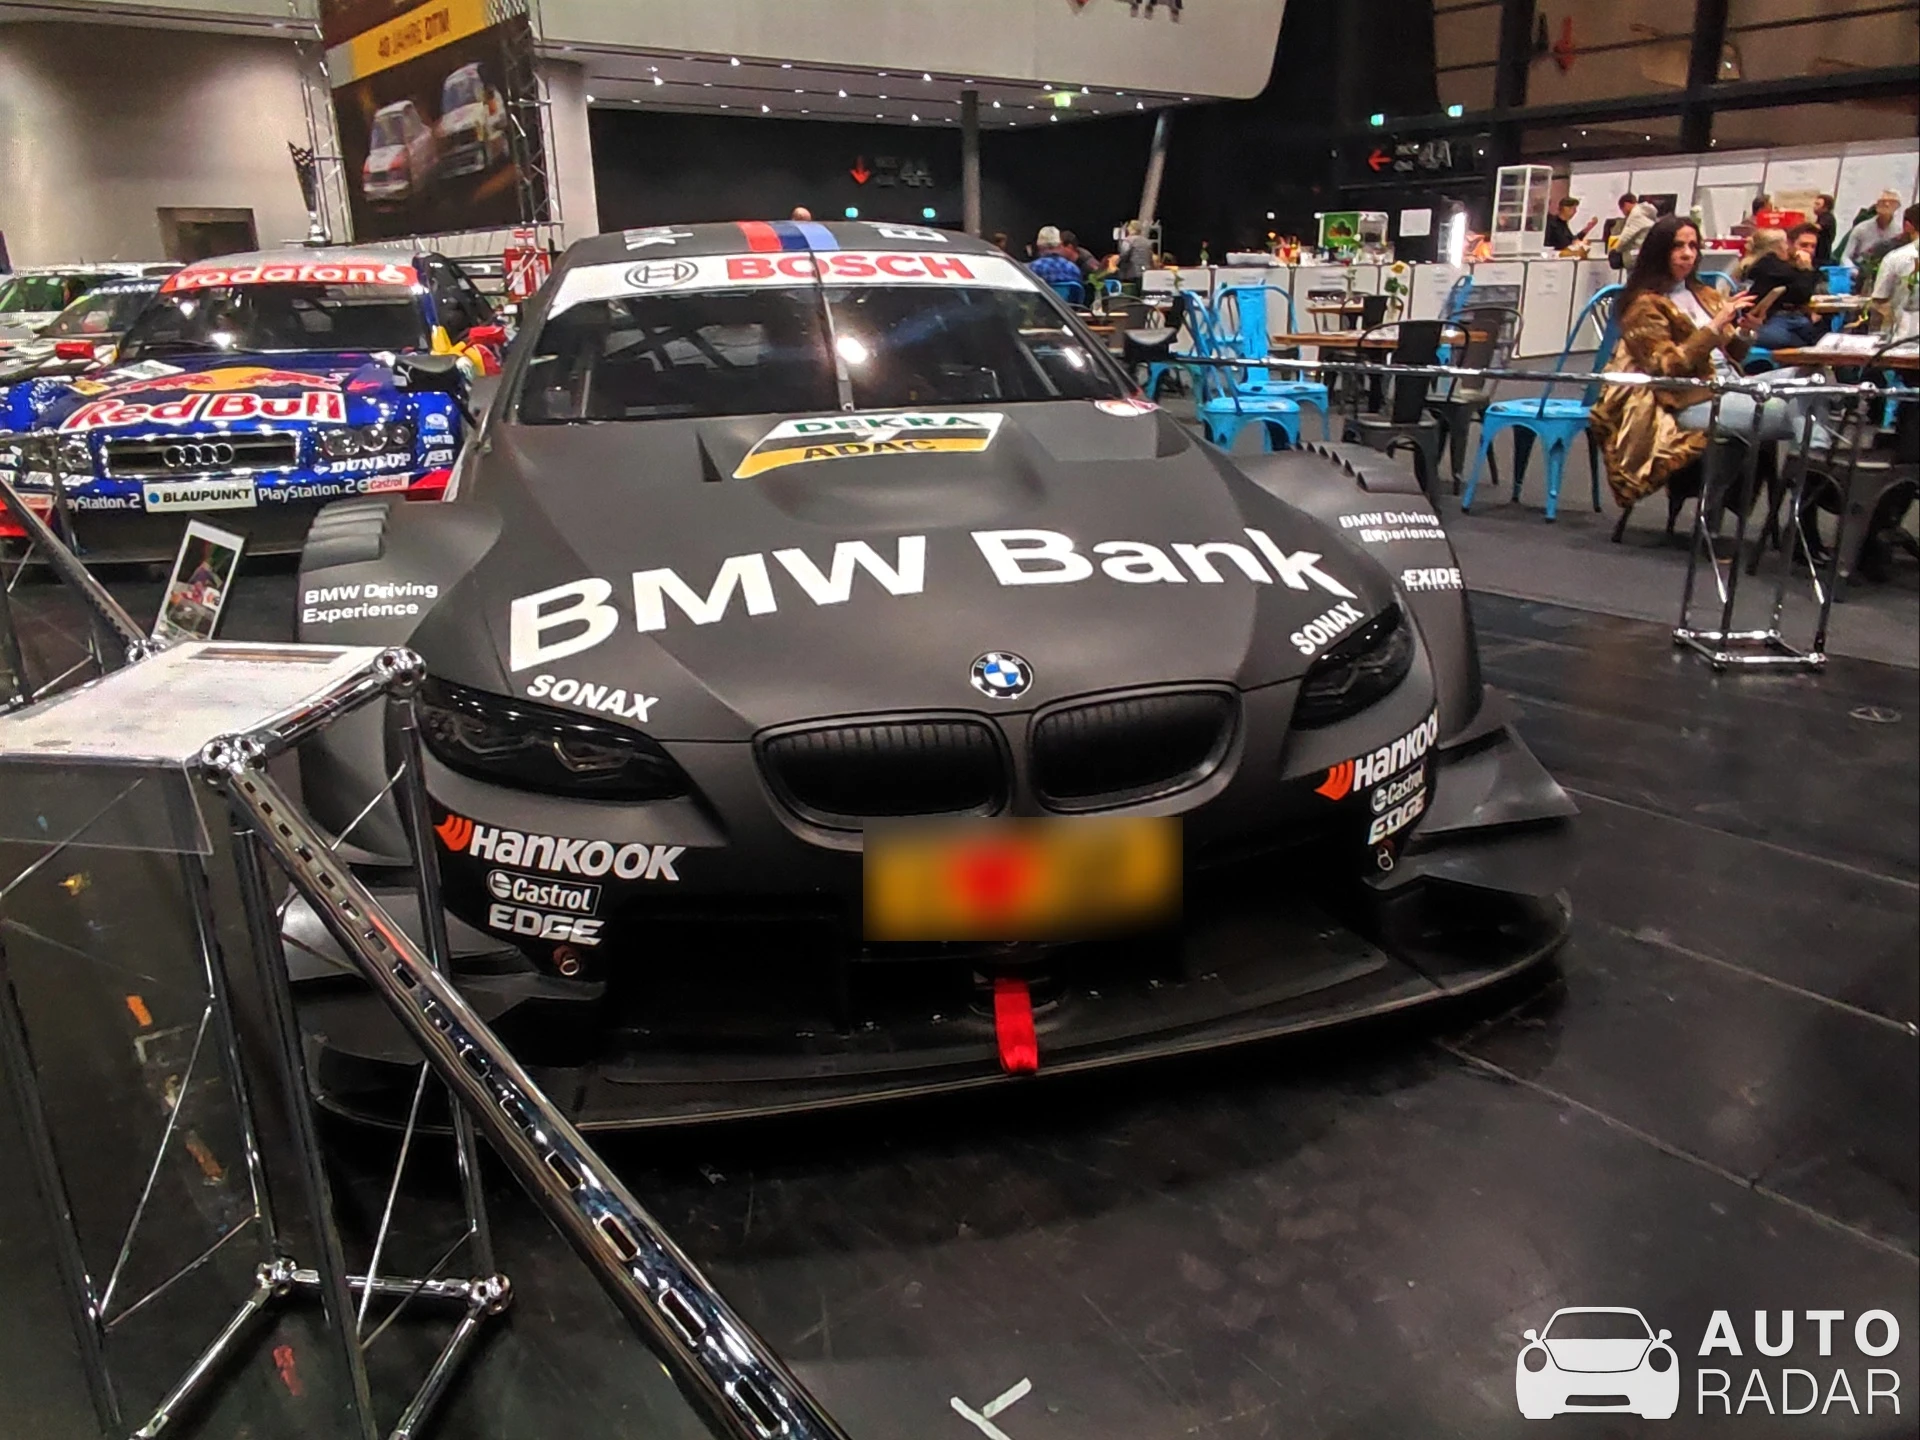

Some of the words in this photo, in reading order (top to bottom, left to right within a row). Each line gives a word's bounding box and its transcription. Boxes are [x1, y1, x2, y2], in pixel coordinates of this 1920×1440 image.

[726, 254, 975, 281] BOSCH
[58, 393, 209, 433] Red
[200, 392, 346, 422] Bull
[794, 416, 982, 433] DEKRA
[803, 438, 937, 461] ADAC
[329, 452, 411, 474] DUNLOP
[129, 493, 141, 508] 2
[163, 488, 251, 503] BLAUPUNKT
[258, 483, 341, 503] PlayStation
[344, 478, 356, 493] 2
[1338, 512, 1383, 528] BMW
[1384, 511, 1439, 526] Driving
[1359, 526, 1445, 543] Experience
[1403, 567, 1462, 586] EXIDE
[304, 585, 360, 604] BMW
[364, 582, 438, 599] Driving
[509, 535, 926, 673] BMW
[970, 527, 1358, 599] Bank
[302, 603, 419, 623] Experience
[1289, 600, 1365, 657] SONAX
[526, 674, 659, 722] SONAX
[1387, 764, 1425, 805] Castrol
[1368, 787, 1427, 845] EDGE
[512, 877, 590, 911] Castrol
[488, 903, 605, 946] EDGE
